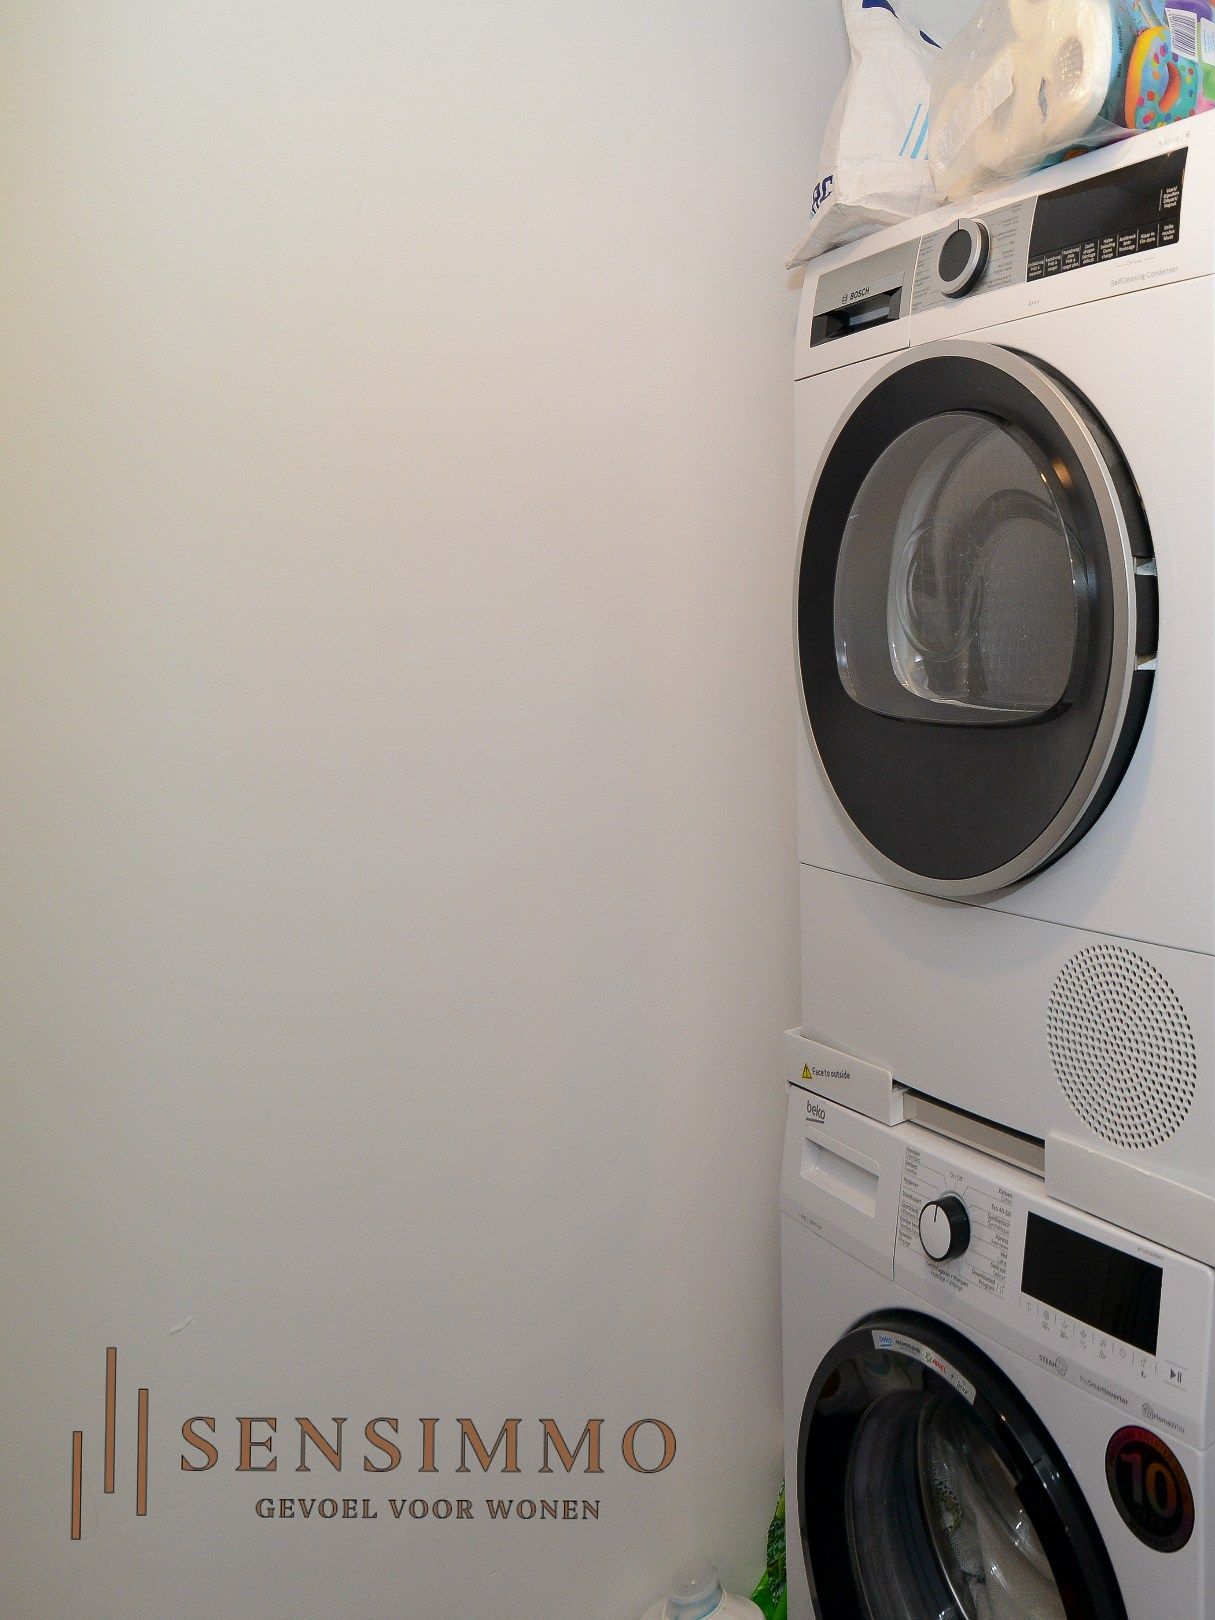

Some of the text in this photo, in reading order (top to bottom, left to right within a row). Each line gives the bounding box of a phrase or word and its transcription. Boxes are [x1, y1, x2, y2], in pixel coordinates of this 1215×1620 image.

[850, 286, 870, 300] BOSCH
[812, 1067, 824, 1077] Face
[831, 1070, 850, 1079] outside
[806, 1100, 826, 1120] beko
